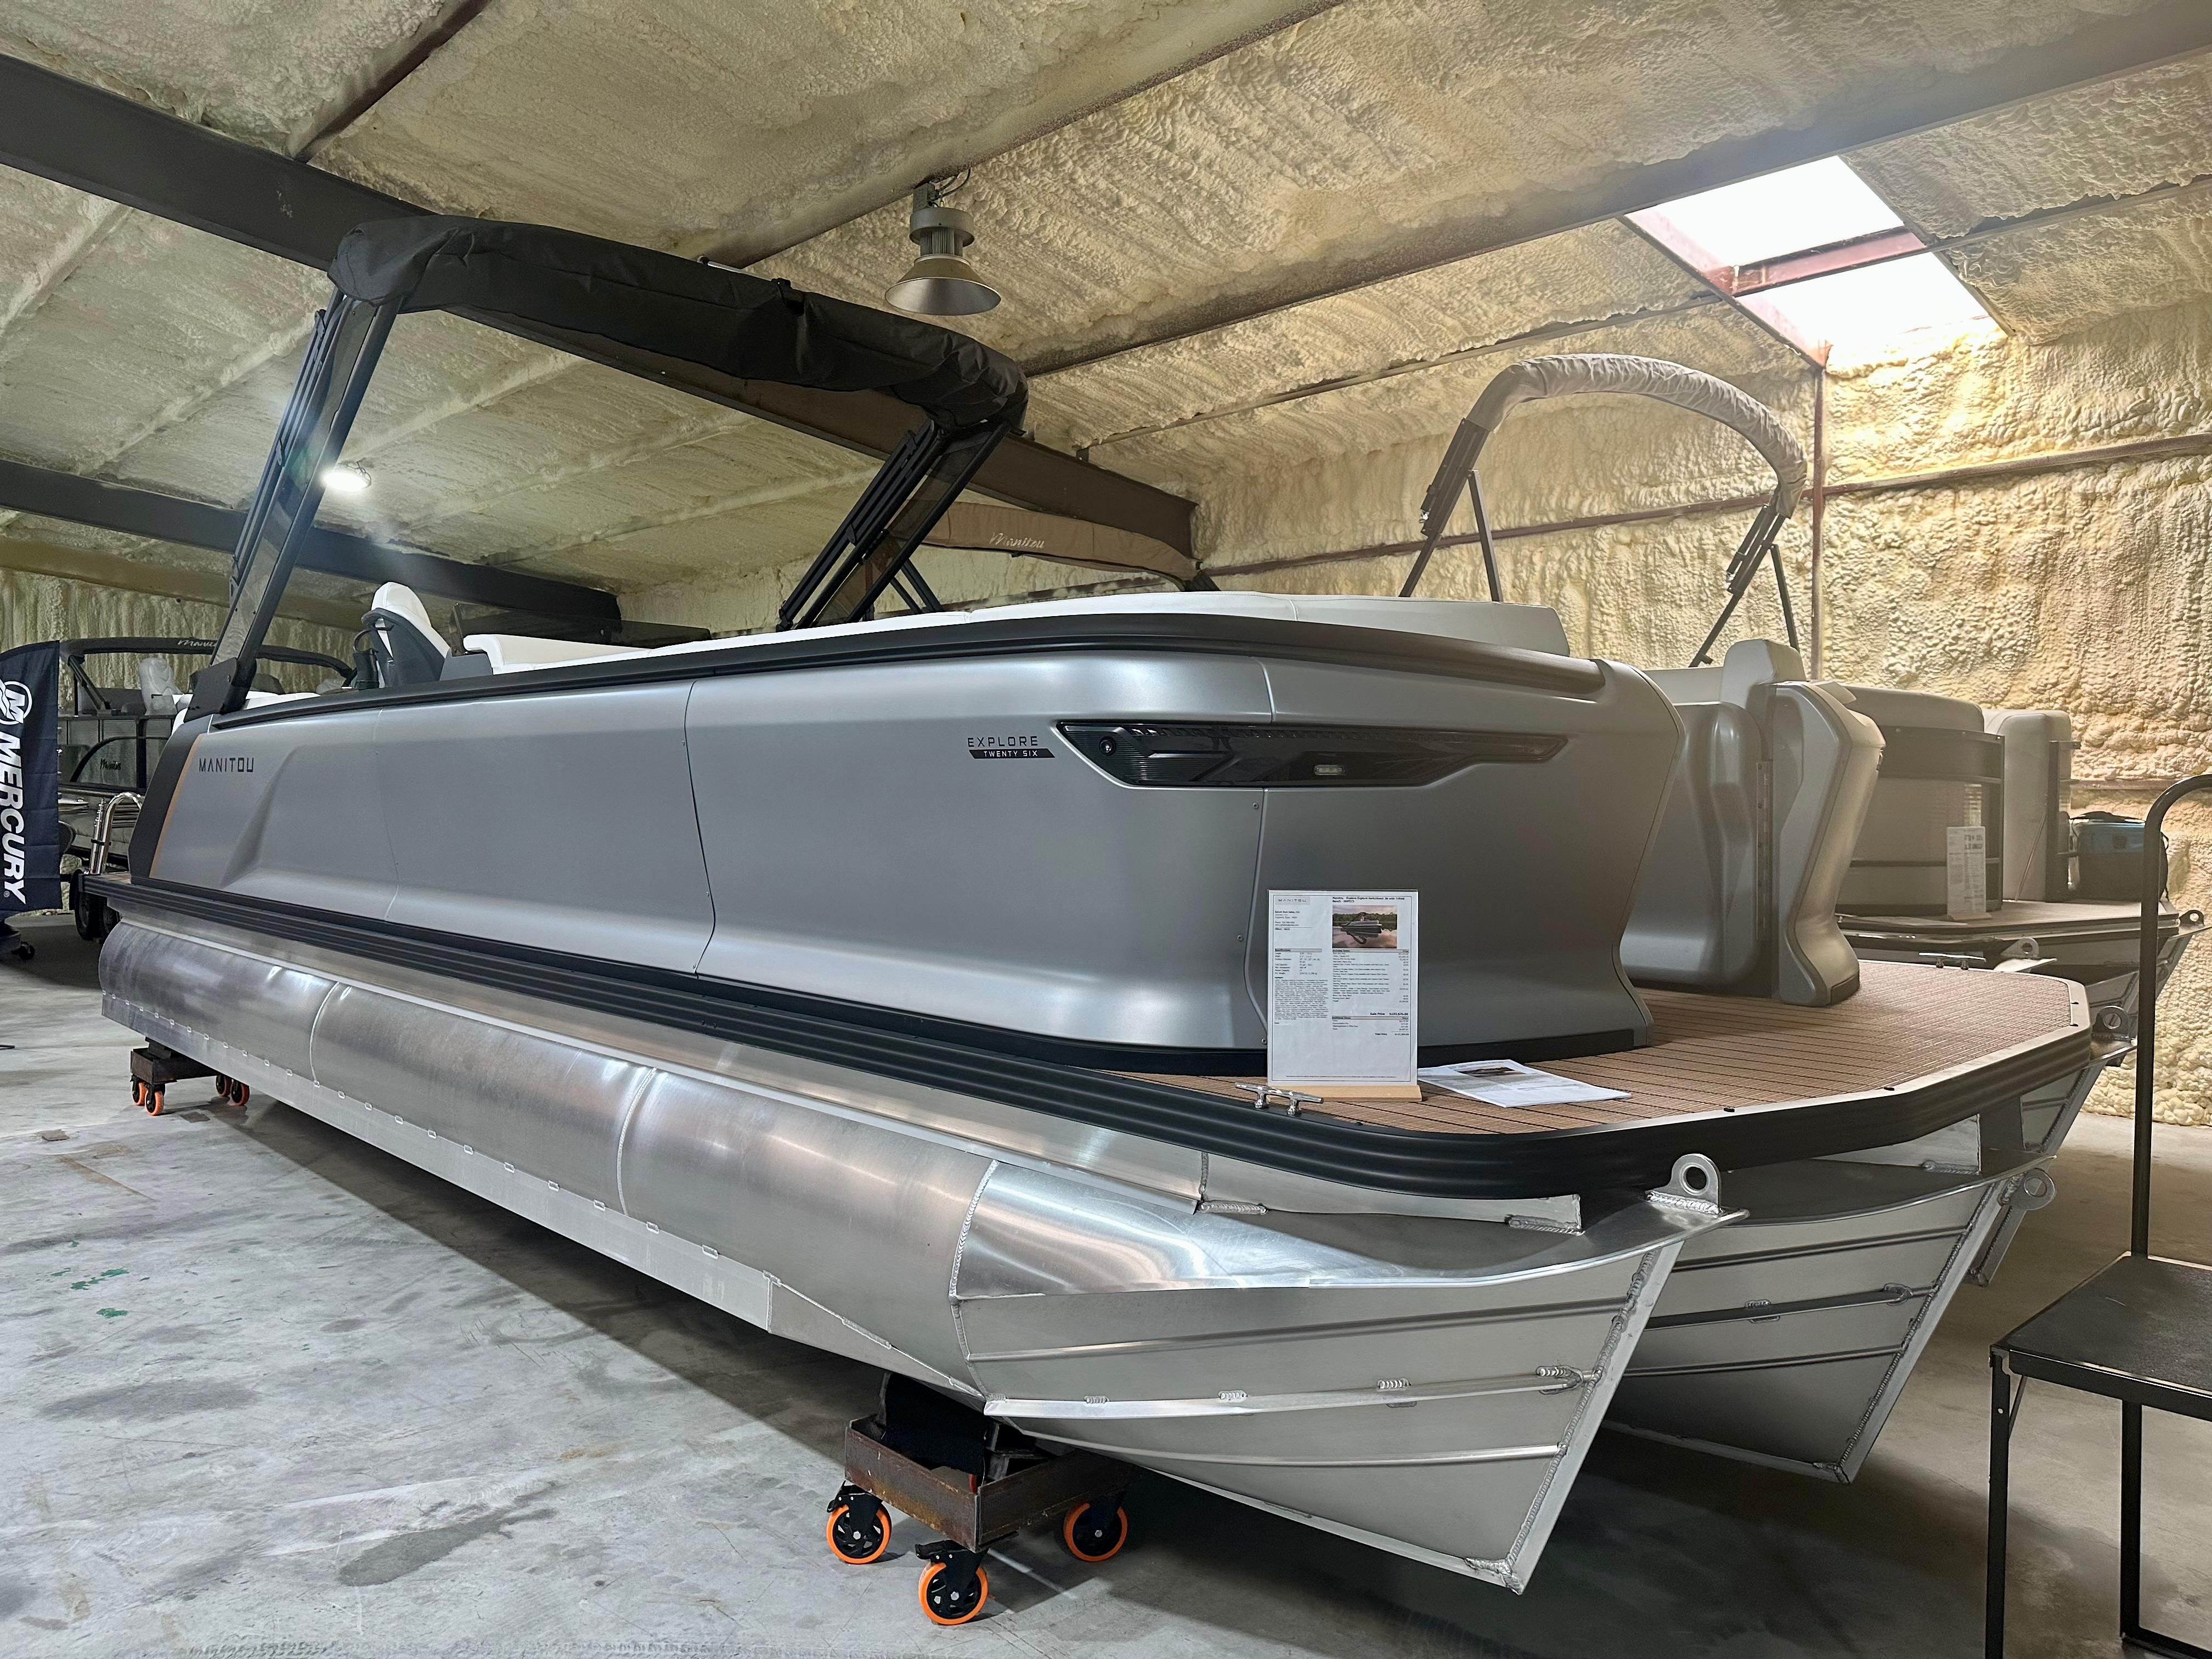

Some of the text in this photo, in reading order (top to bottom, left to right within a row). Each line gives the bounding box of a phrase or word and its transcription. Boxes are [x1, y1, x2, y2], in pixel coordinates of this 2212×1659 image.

[989, 532, 1045, 549] Manitou
[967, 736, 1038, 747] EXPLORE
[199, 757, 254, 772] MANITOU
[0, 733, 26, 905] MERCURY
